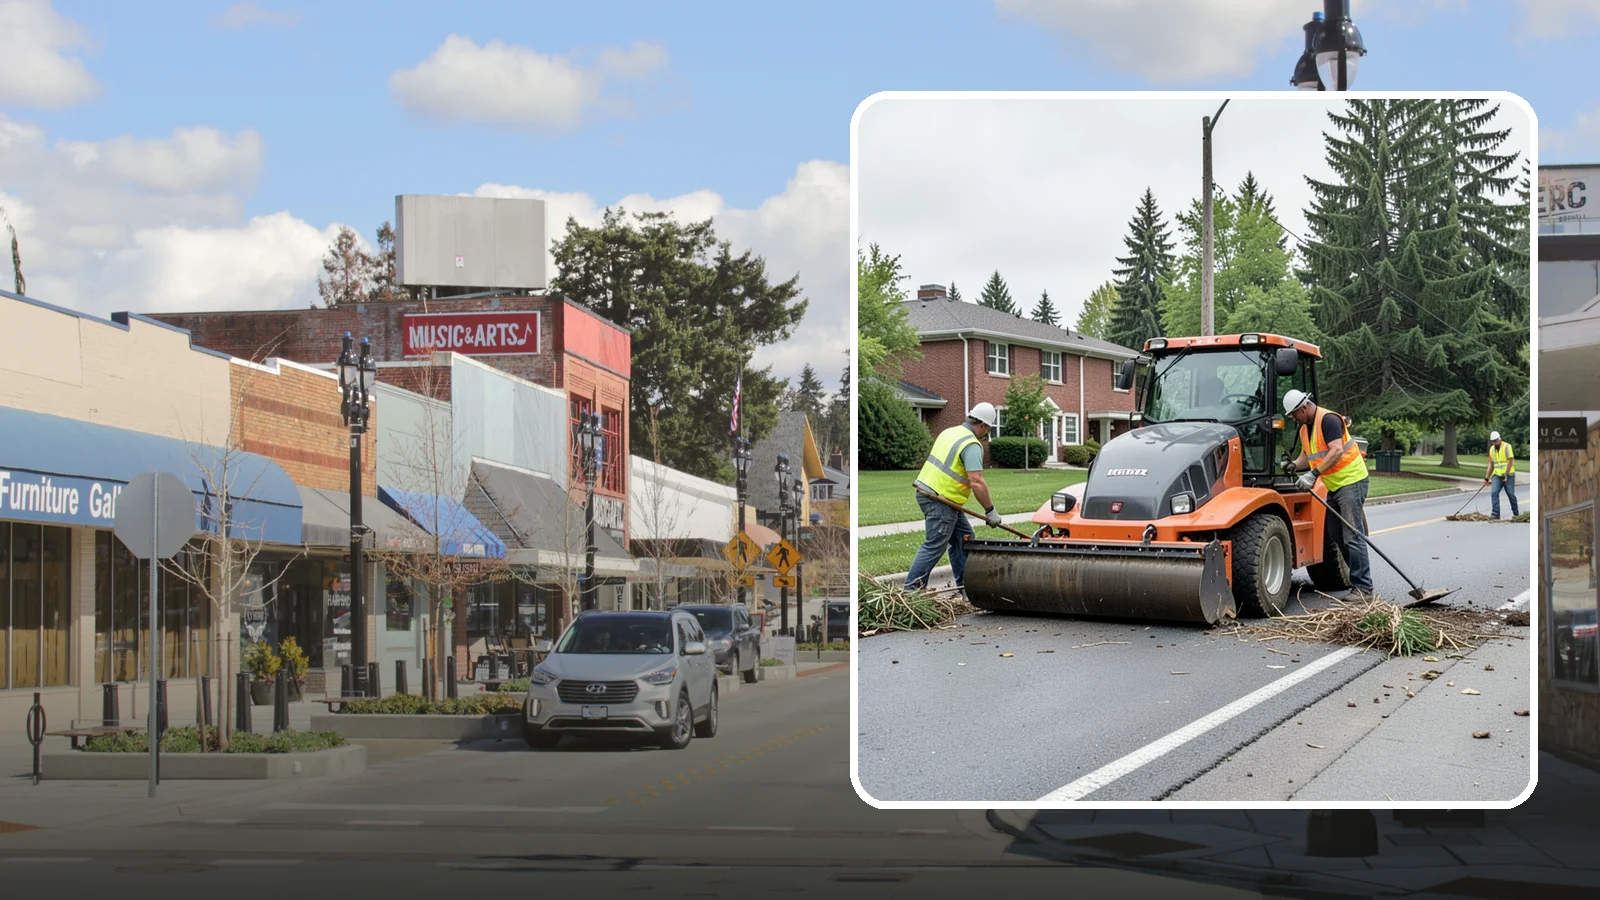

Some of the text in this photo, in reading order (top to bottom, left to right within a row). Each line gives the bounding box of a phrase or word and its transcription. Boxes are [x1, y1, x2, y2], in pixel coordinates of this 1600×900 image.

[1540, 428, 1577, 436] UGA
[0, 470, 122, 519] Furniture Gal
[453, 563, 479, 574] SUSHI
